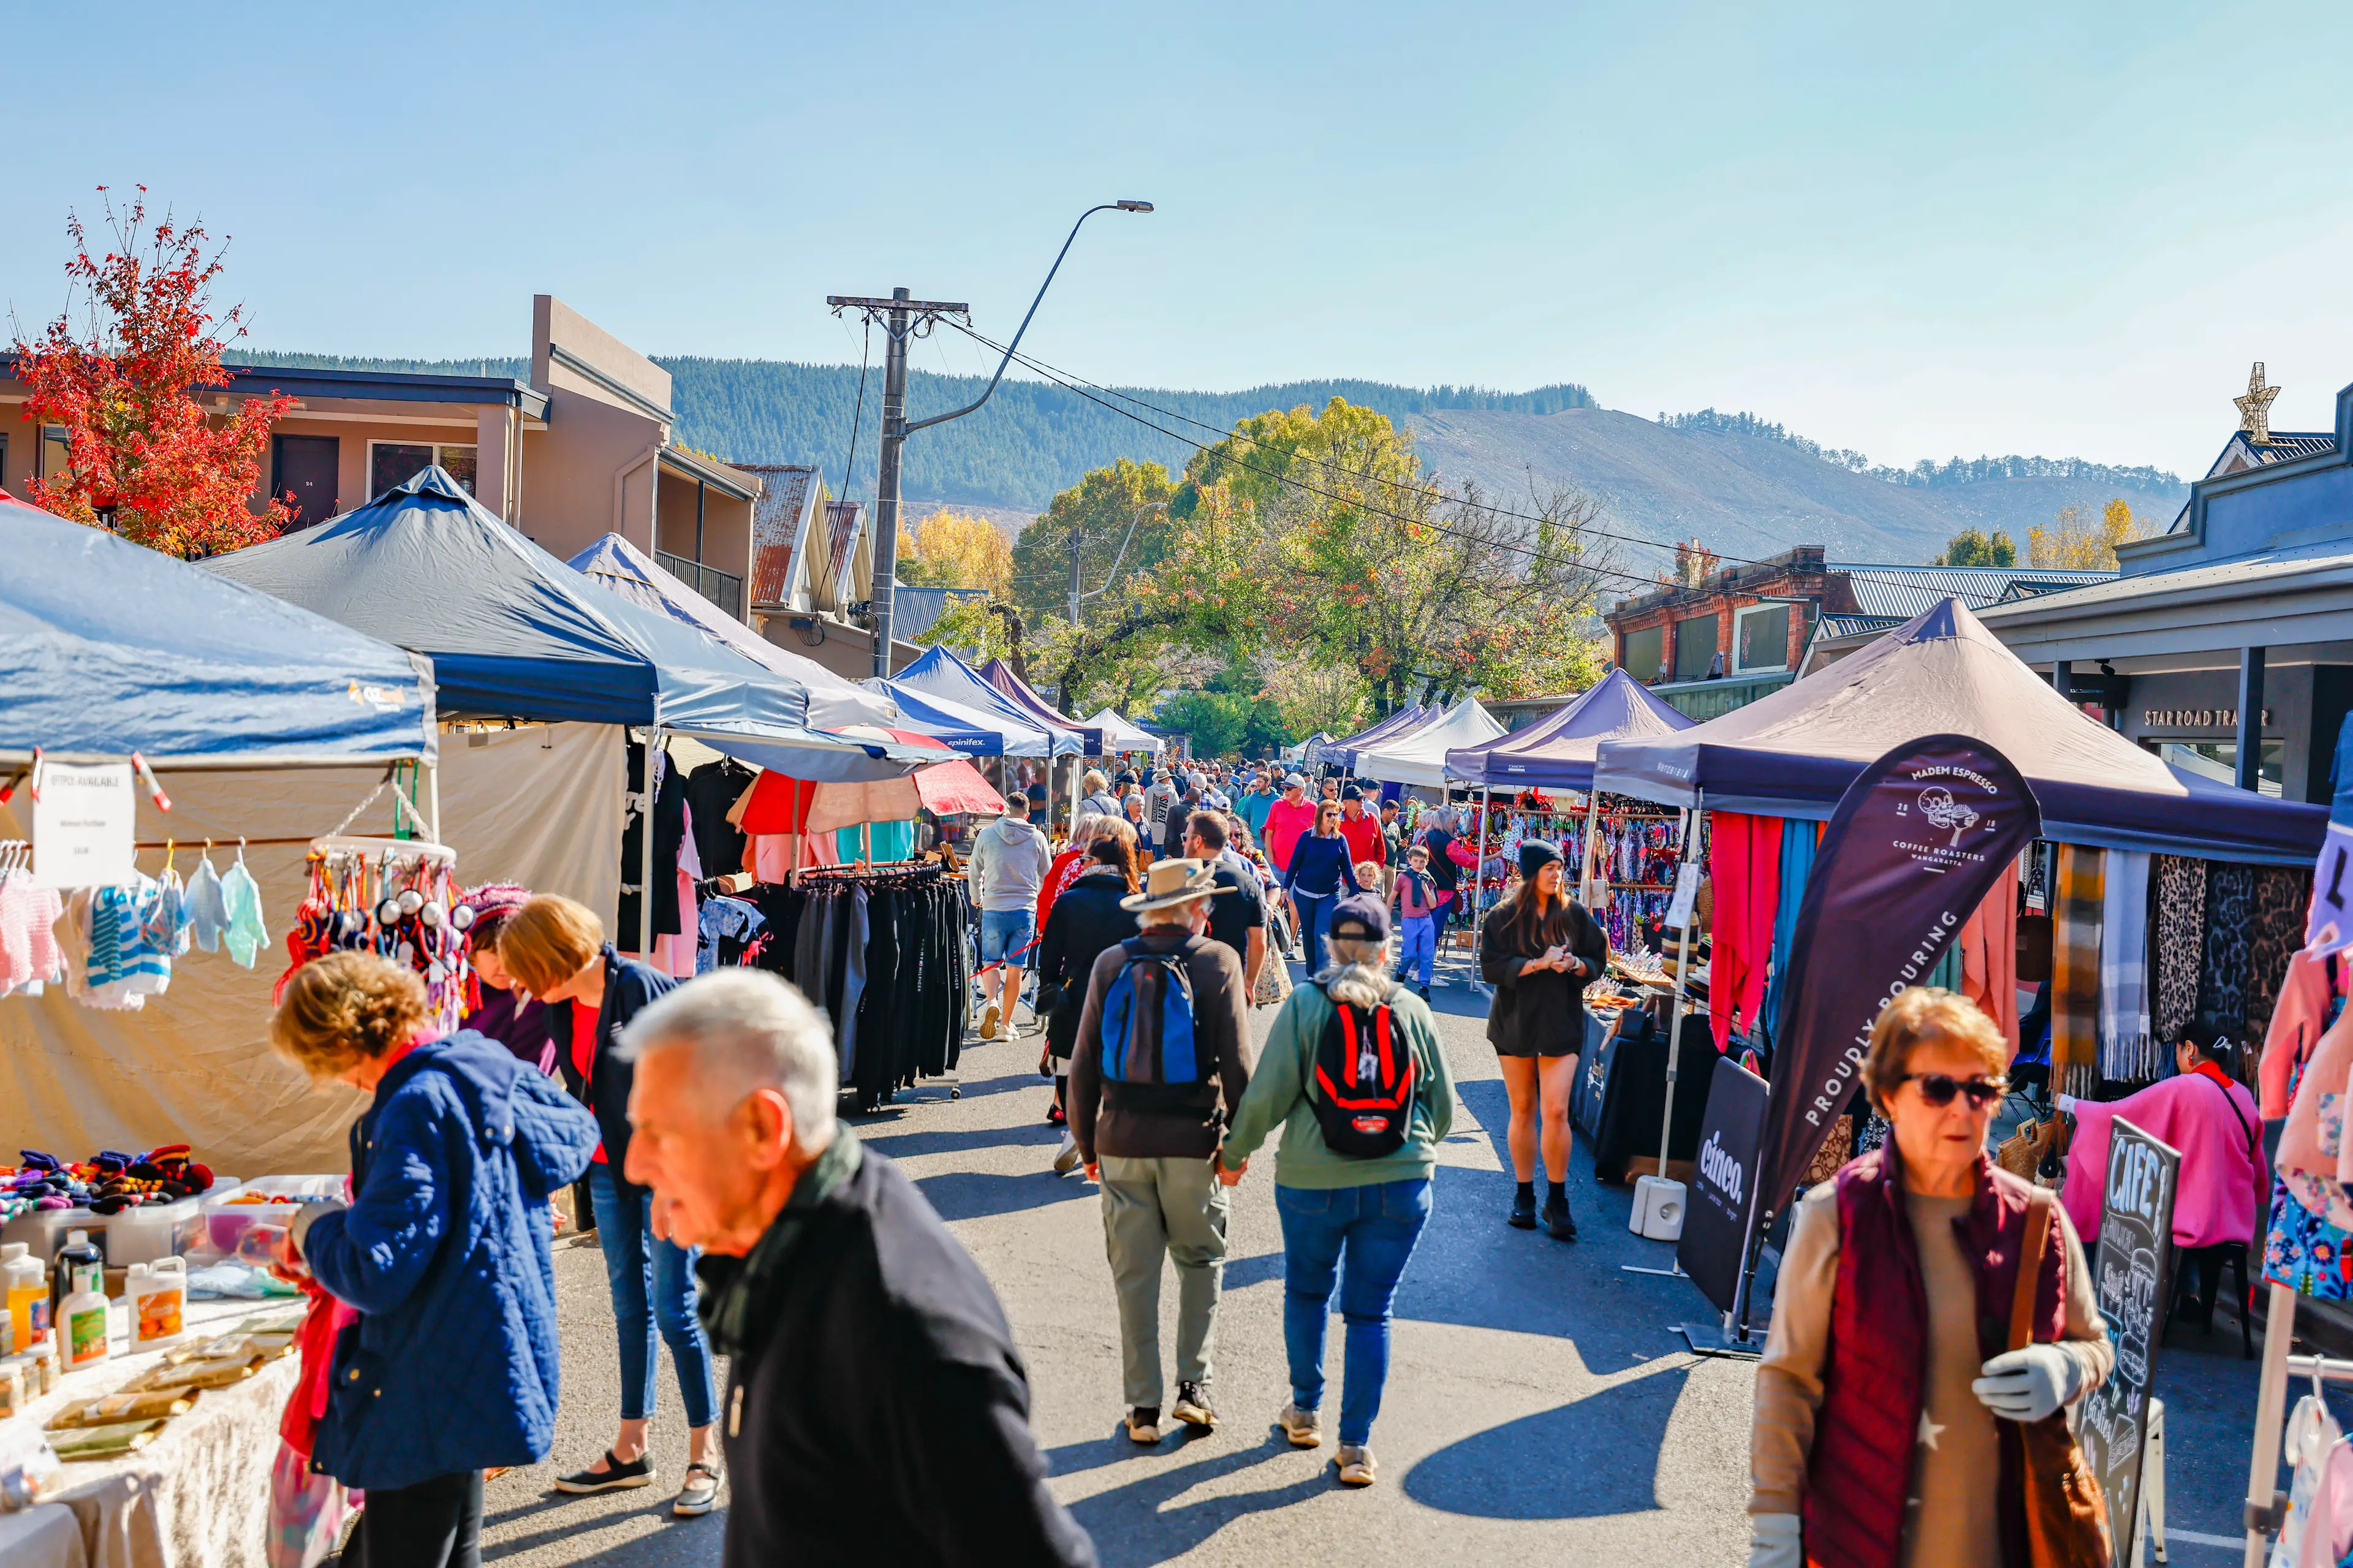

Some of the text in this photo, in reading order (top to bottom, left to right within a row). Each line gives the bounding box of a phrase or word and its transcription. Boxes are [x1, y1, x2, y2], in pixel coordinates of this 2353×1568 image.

[2145, 710, 2268, 726] STAR ROAD TRAR
[1911, 766, 1998, 794] MADEM ESPRESSO
[1158, 797, 1169, 825] SILENT
[1897, 803, 1908, 811] 20
[1893, 840, 1985, 862] COFFEE ROASTERS
[1911, 854, 1962, 866] WANGARATTA
[1805, 911, 1957, 1126] PROUDLY POURING
[2109, 1137, 2159, 1219] CAFE
[2104, 1213, 2135, 1256] SANDWICHES
